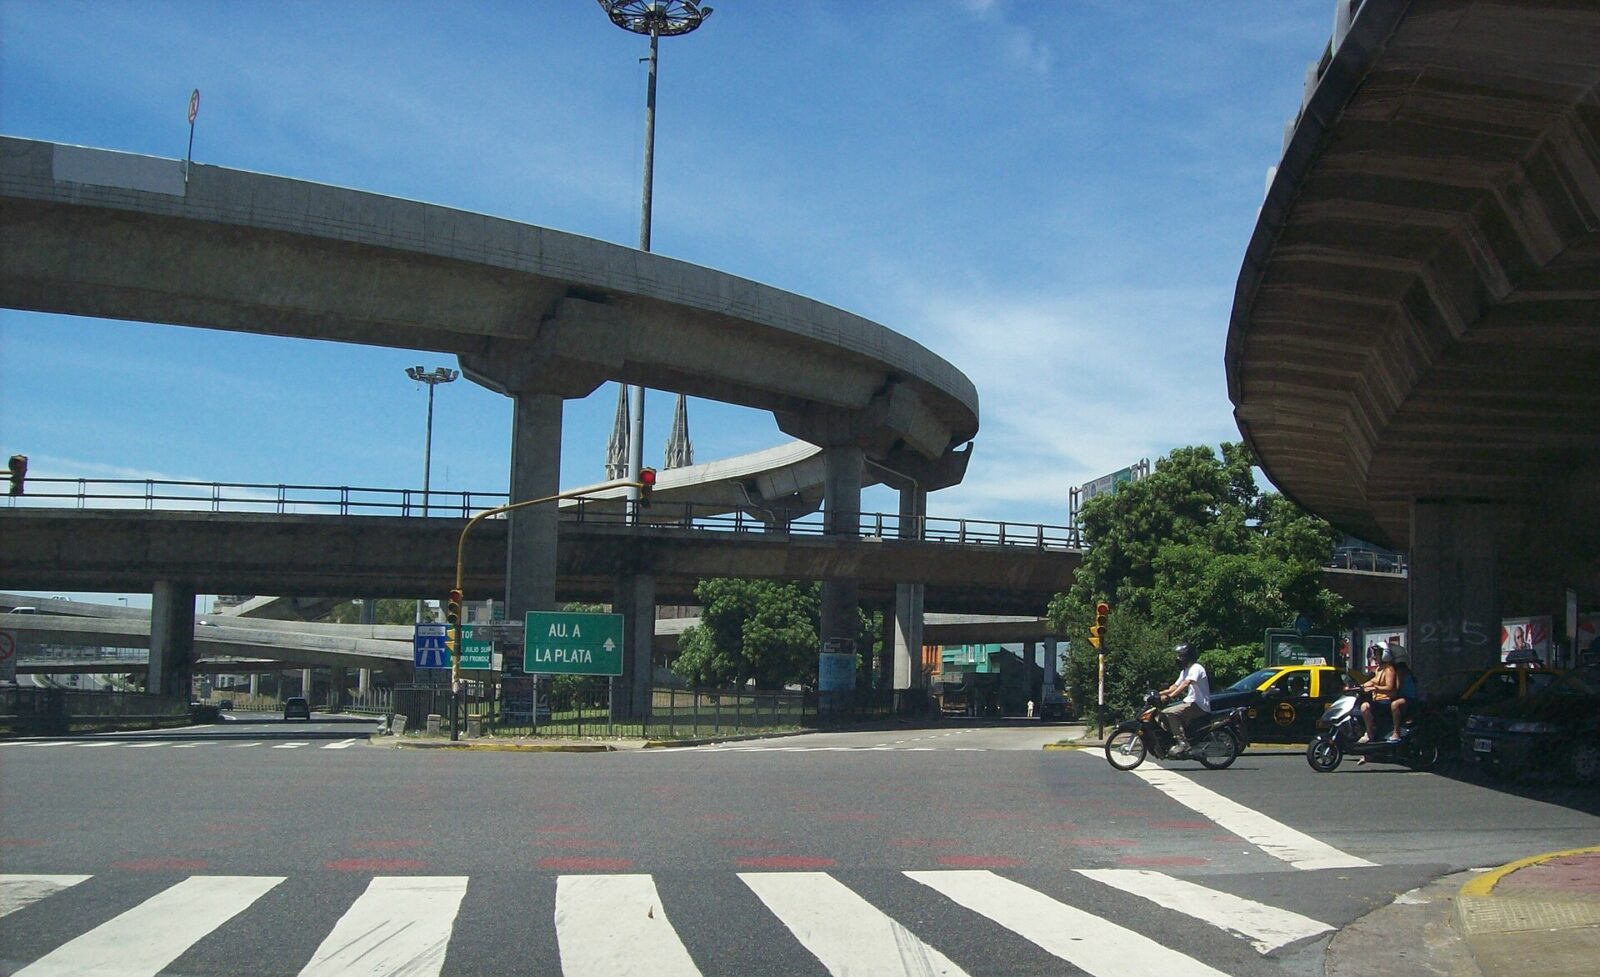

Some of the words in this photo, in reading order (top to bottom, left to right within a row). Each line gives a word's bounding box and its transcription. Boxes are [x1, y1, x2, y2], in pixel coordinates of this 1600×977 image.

[548, 623, 568, 637] AU.
[572, 624, 580, 637] A
[535, 648, 552, 663] LA
[554, 648, 592, 664] PLATA
